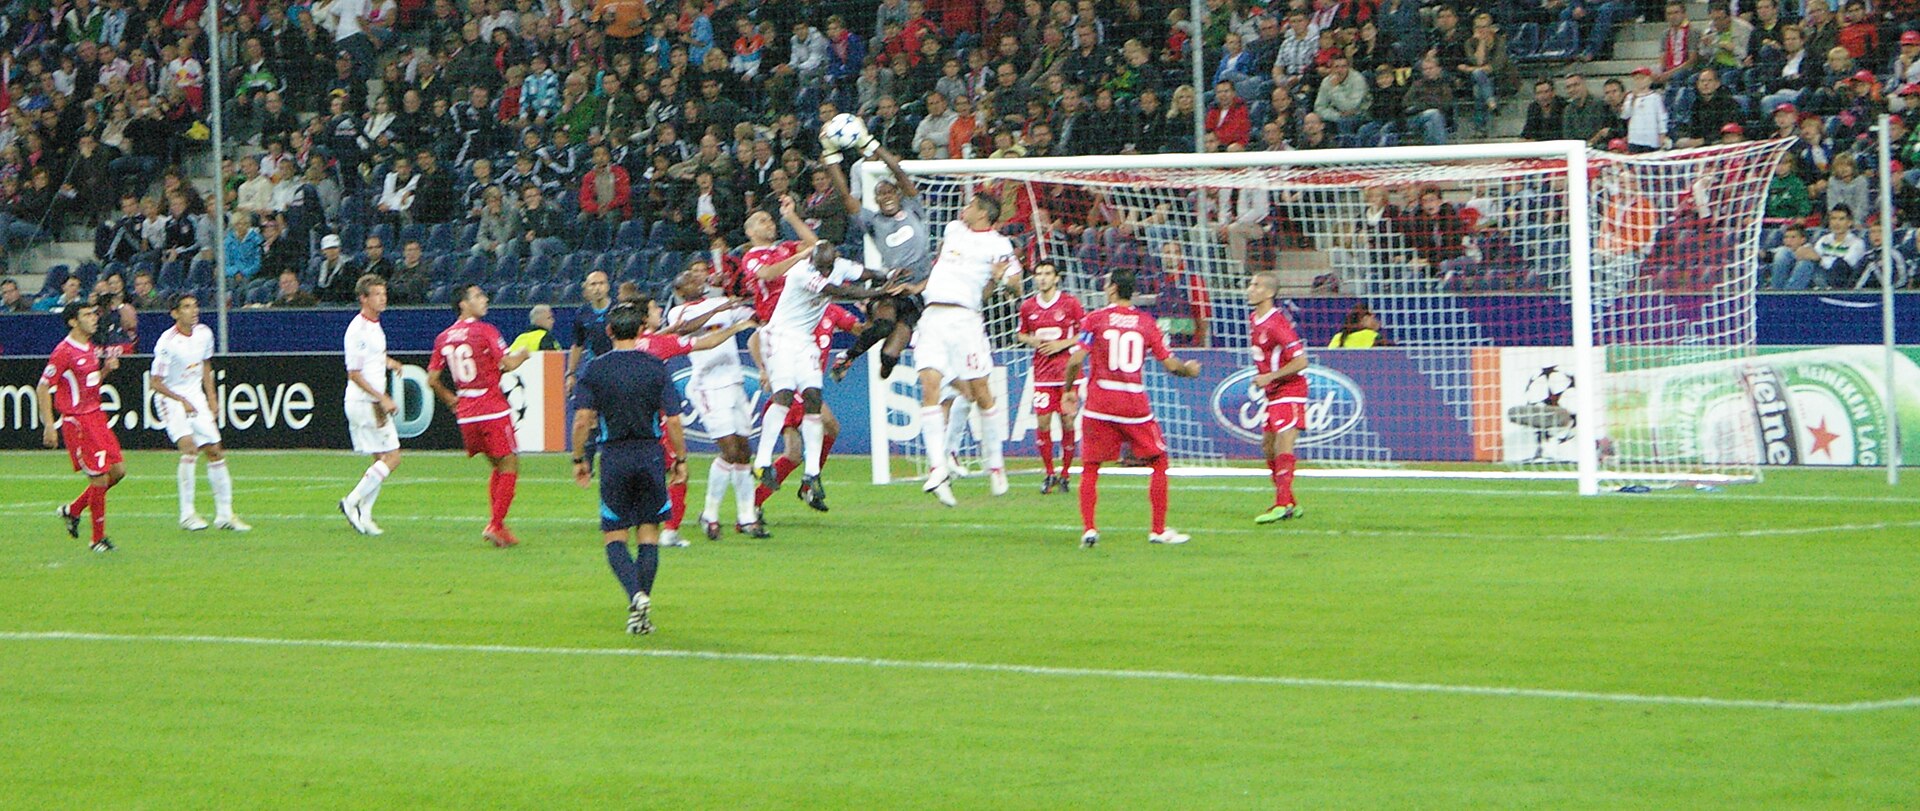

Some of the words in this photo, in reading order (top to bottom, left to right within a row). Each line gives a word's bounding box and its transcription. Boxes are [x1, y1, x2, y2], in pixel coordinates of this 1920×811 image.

[441, 343, 478, 383] 16
[1102, 329, 1145, 373] 10
[0, 369, 315, 430] me.bieve
[1032, 391, 1050, 409] 23
[1239, 383, 1337, 431] Fd
[94, 450, 106, 468] 7
